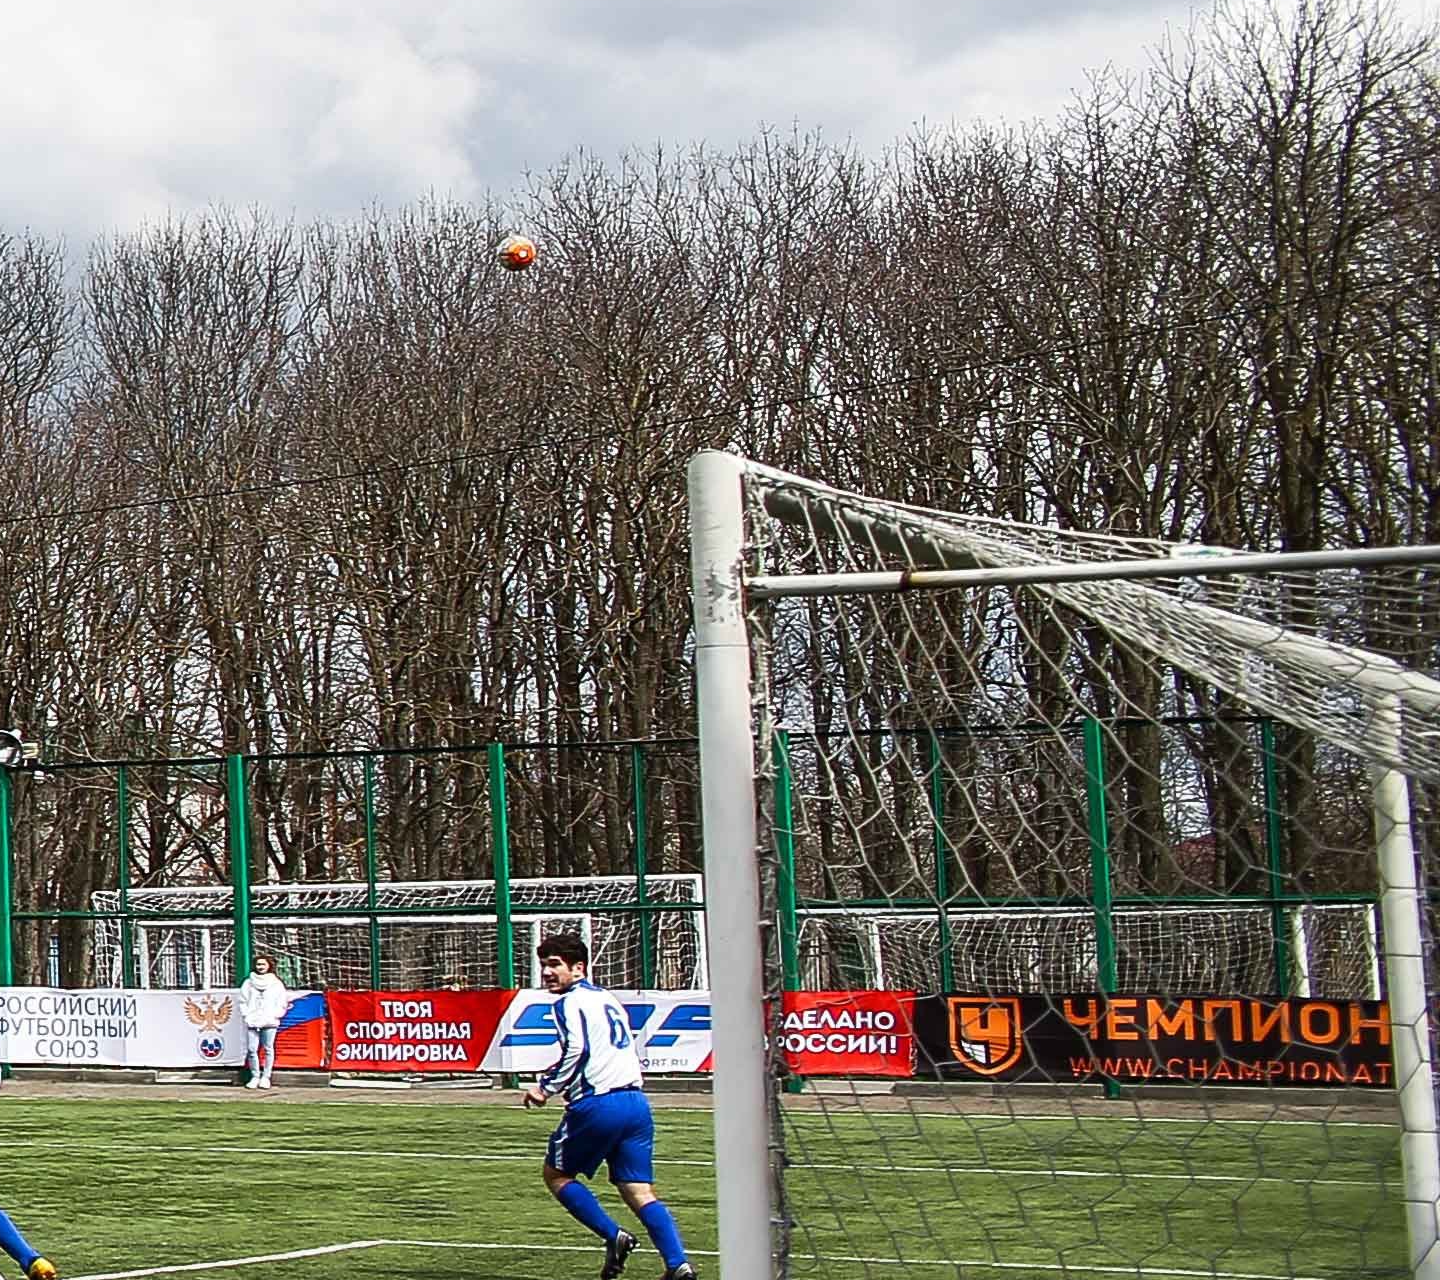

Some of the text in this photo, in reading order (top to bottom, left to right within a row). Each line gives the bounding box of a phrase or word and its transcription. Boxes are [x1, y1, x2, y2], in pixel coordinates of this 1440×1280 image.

[380, 1000, 433, 1019] ТВОЯ
[604, 1003, 630, 1049] 6
[1063, 999, 1390, 1044] ЧЕМПИОН
[345, 1022, 471, 1041] СПОРТИВНАЯ
[35, 1039, 99, 1059] СОЮЗ
[335, 1043, 468, 1062] ЭКИПИРОВКА
